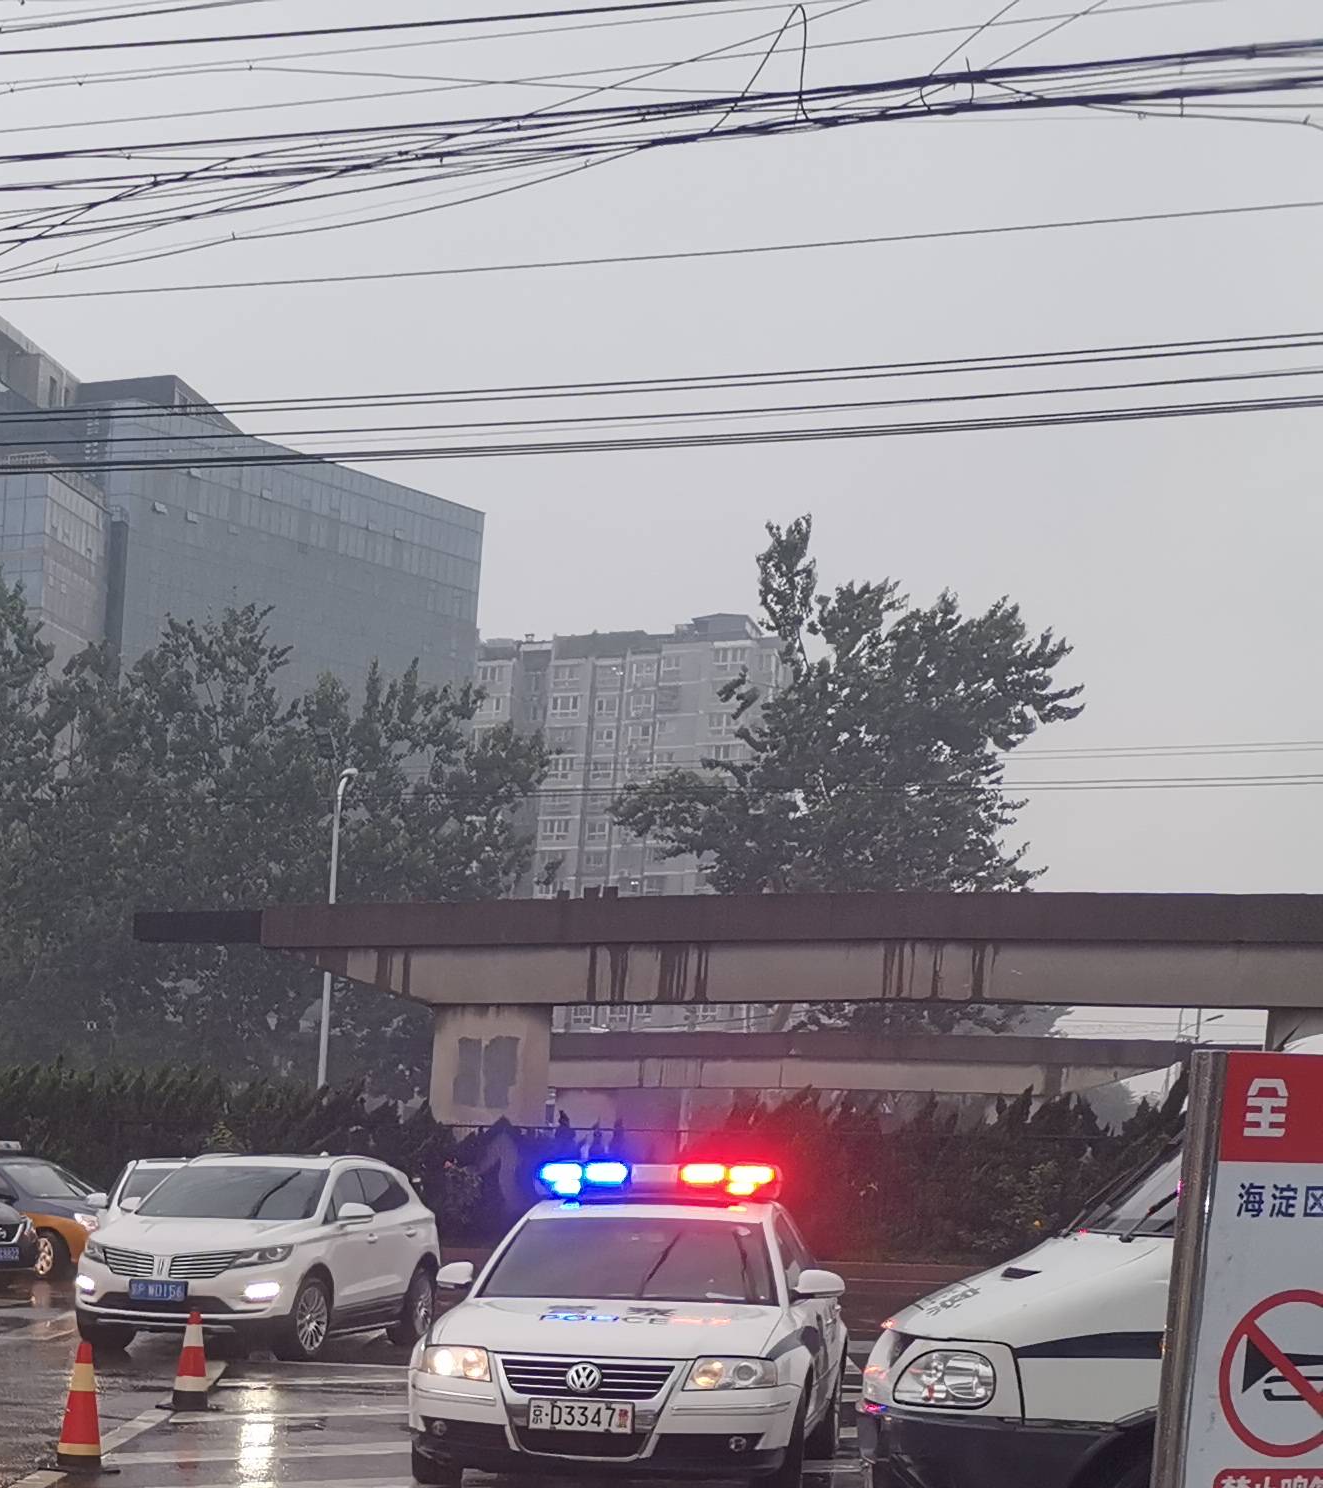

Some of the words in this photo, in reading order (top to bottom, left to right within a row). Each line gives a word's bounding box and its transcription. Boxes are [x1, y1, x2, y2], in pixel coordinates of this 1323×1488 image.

[1243, 1078, 1289, 1137] 全
[1237, 1182, 1323, 1218] 海淀区
